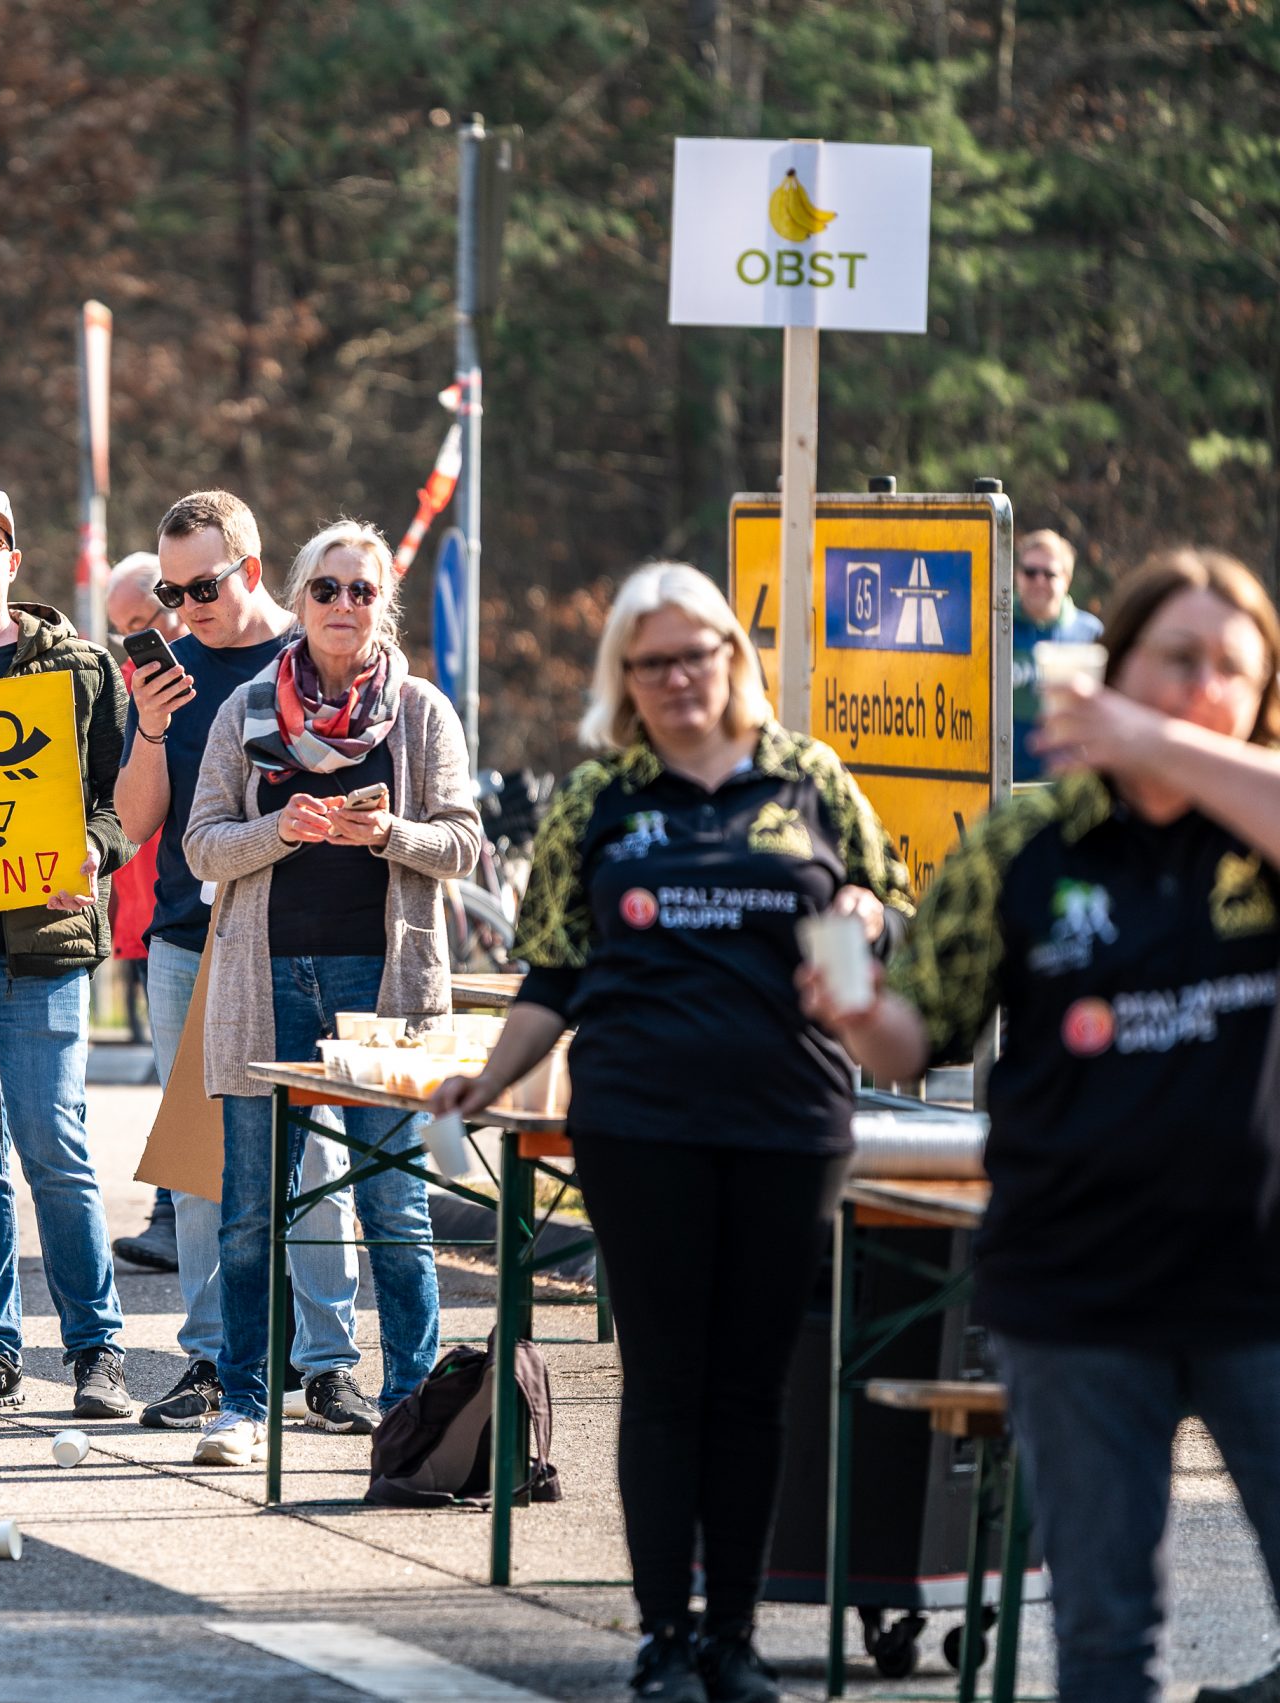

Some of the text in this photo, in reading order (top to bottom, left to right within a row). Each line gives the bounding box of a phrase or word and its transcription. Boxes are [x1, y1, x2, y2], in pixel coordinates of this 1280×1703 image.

[736, 249, 868, 289] OBST
[855, 578, 872, 620] 65
[825, 676, 973, 750] Hagenbach 8 km
[914, 848, 935, 893] km
[659, 907, 743, 929] GRUPPE
